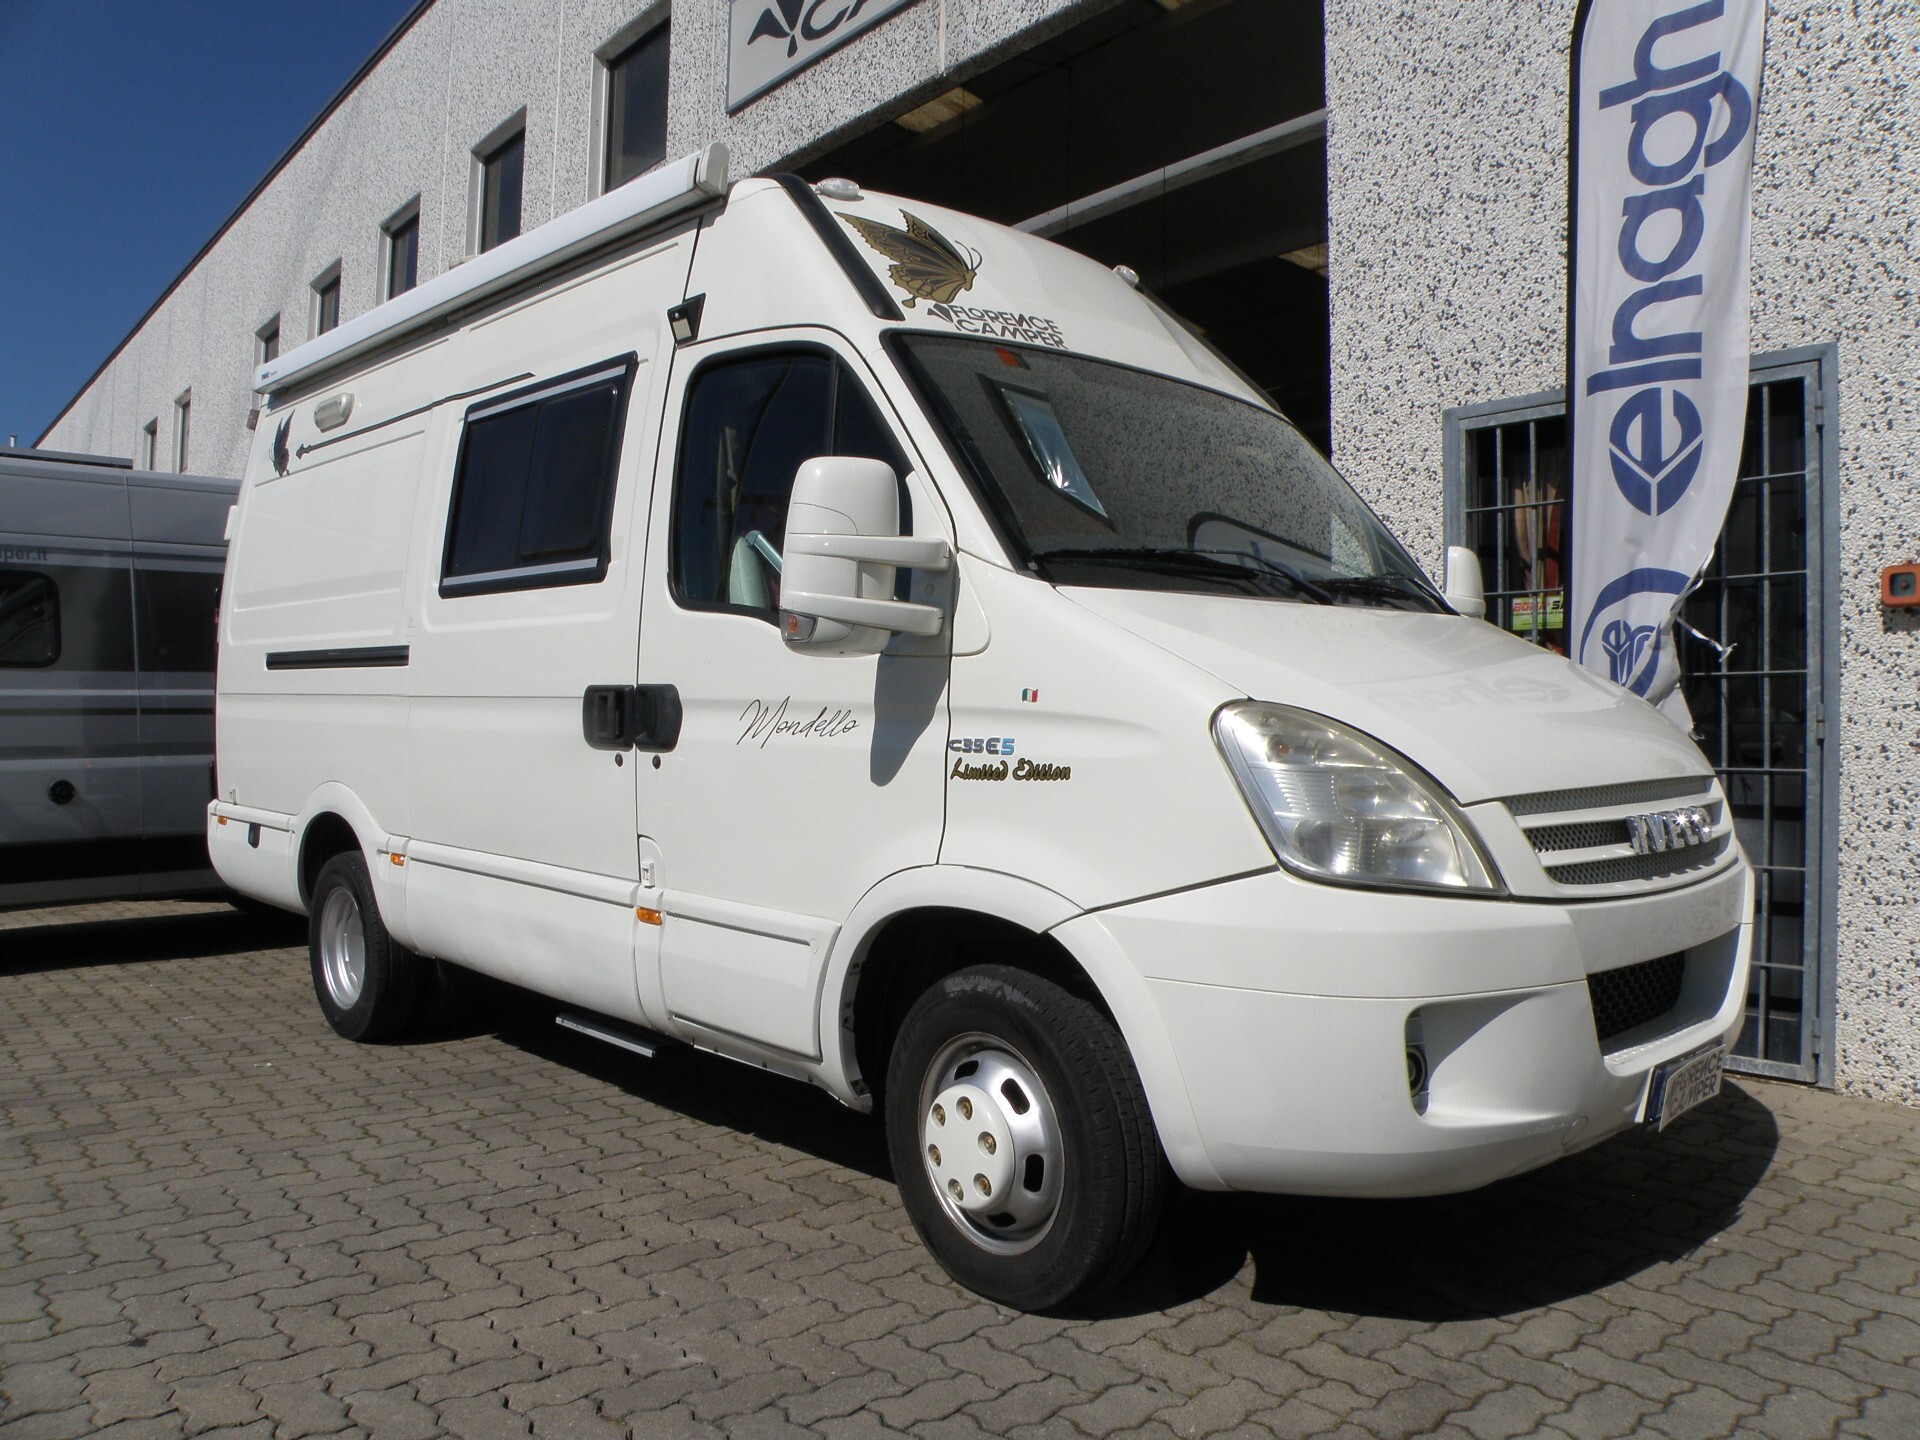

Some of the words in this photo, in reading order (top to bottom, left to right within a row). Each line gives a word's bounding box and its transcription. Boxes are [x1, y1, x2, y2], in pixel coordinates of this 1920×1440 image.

[1587, 0, 1752, 516] elnagh
[947, 304, 1063, 336] FLORENCE
[955, 318, 1070, 350] CAMPER
[0, 546, 49, 562] per.it
[736, 695, 860, 749] Mondello
[950, 757, 1009, 781] Limited
[1012, 757, 1071, 781] Edition
[1625, 805, 1712, 855] IVECO
